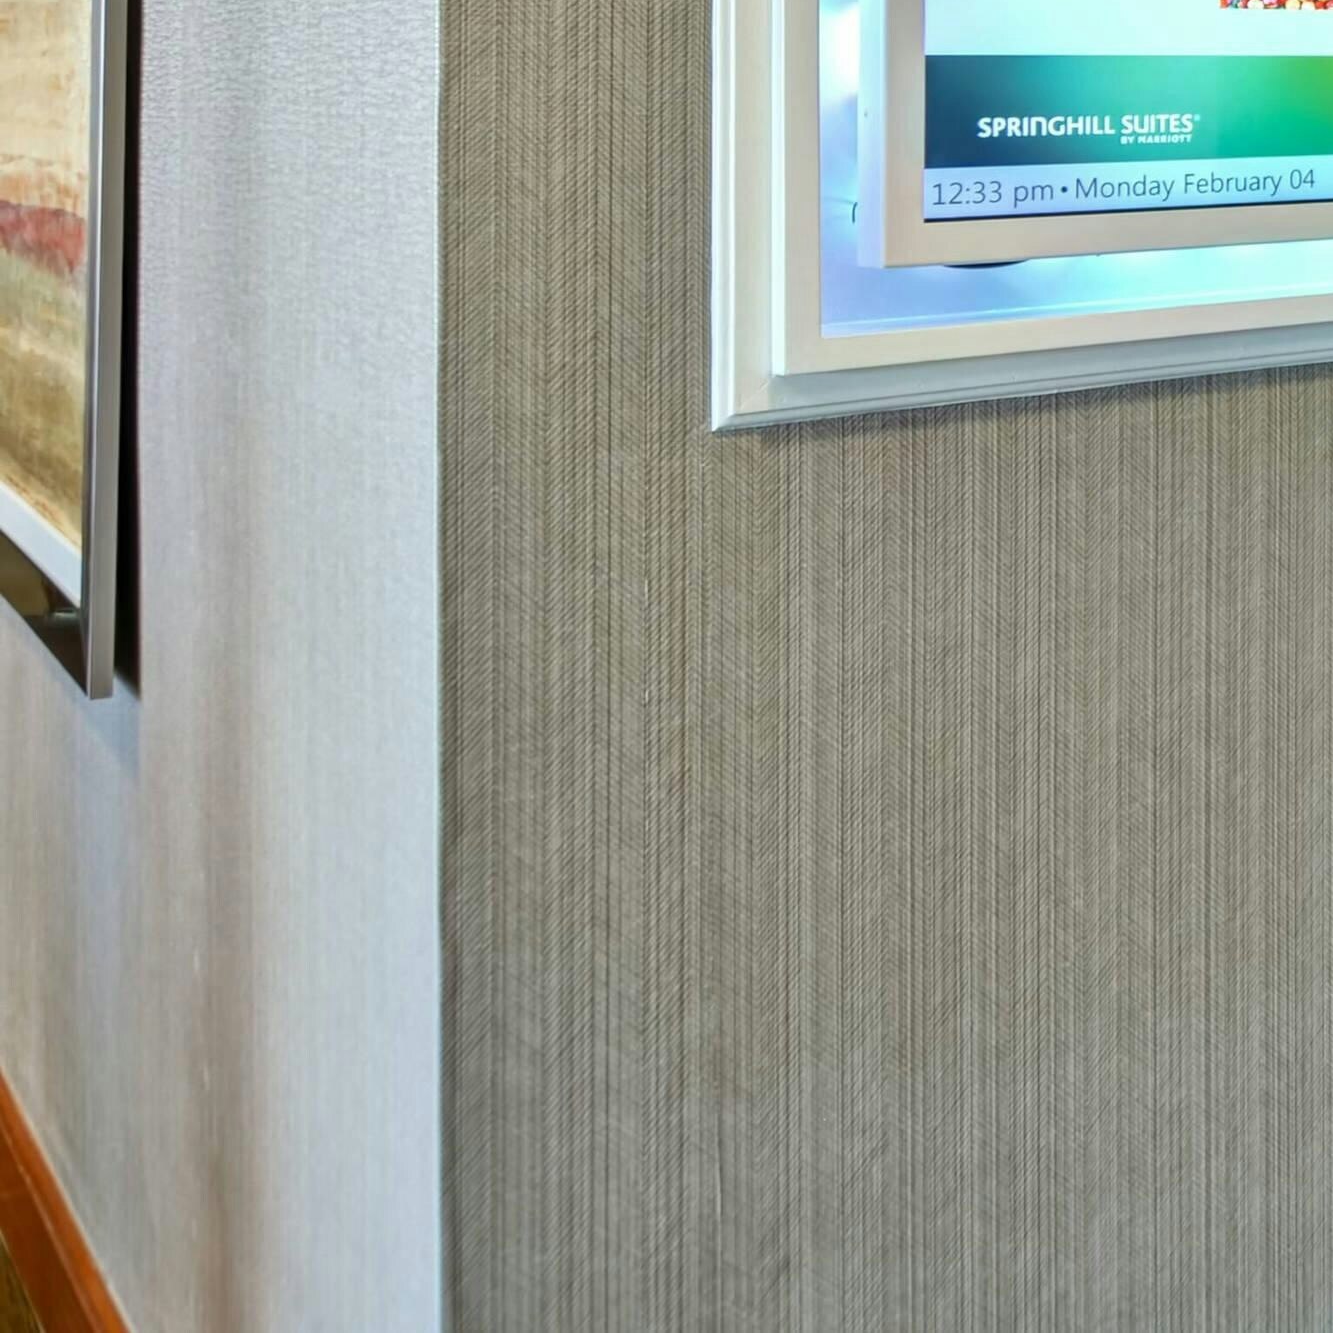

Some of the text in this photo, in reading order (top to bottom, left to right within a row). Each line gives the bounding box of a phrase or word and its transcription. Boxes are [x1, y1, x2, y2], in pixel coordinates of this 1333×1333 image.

[976, 113, 1194, 138] SPRINGHILL SUITES
[1120, 134, 1193, 145] BY MARRIOTT
[931, 168, 1315, 208] 12:33 pm Monday February 04
